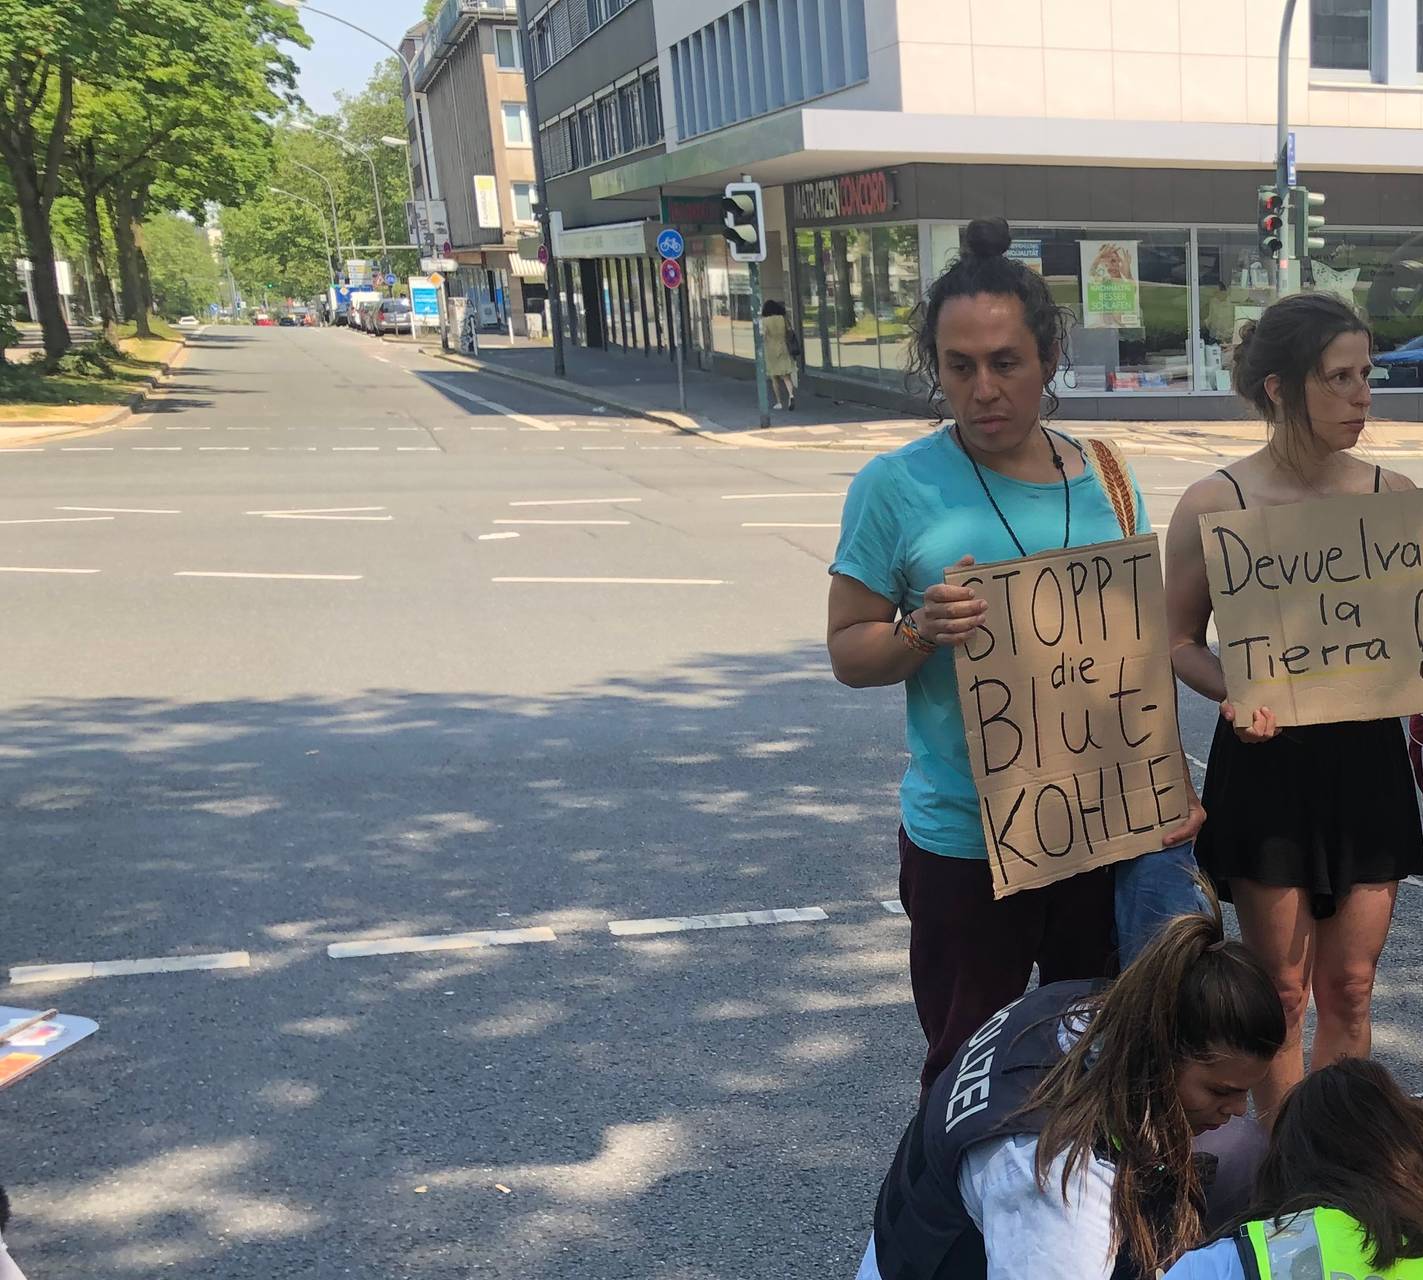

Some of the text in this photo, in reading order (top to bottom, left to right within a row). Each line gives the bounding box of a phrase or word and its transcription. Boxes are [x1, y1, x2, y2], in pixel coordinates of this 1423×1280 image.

[794, 171, 886, 220] MATRATZEN CONCORD
[1090, 301, 1131, 311] SCHLAFEN
[1098, 292, 1127, 301] BESSER
[962, 553, 1152, 662] STOPPT
[1319, 593, 1362, 628] la
[1051, 656, 1096, 691] die
[1227, 635, 1391, 682] Tierra
[983, 755, 1182, 885] KOHLE
